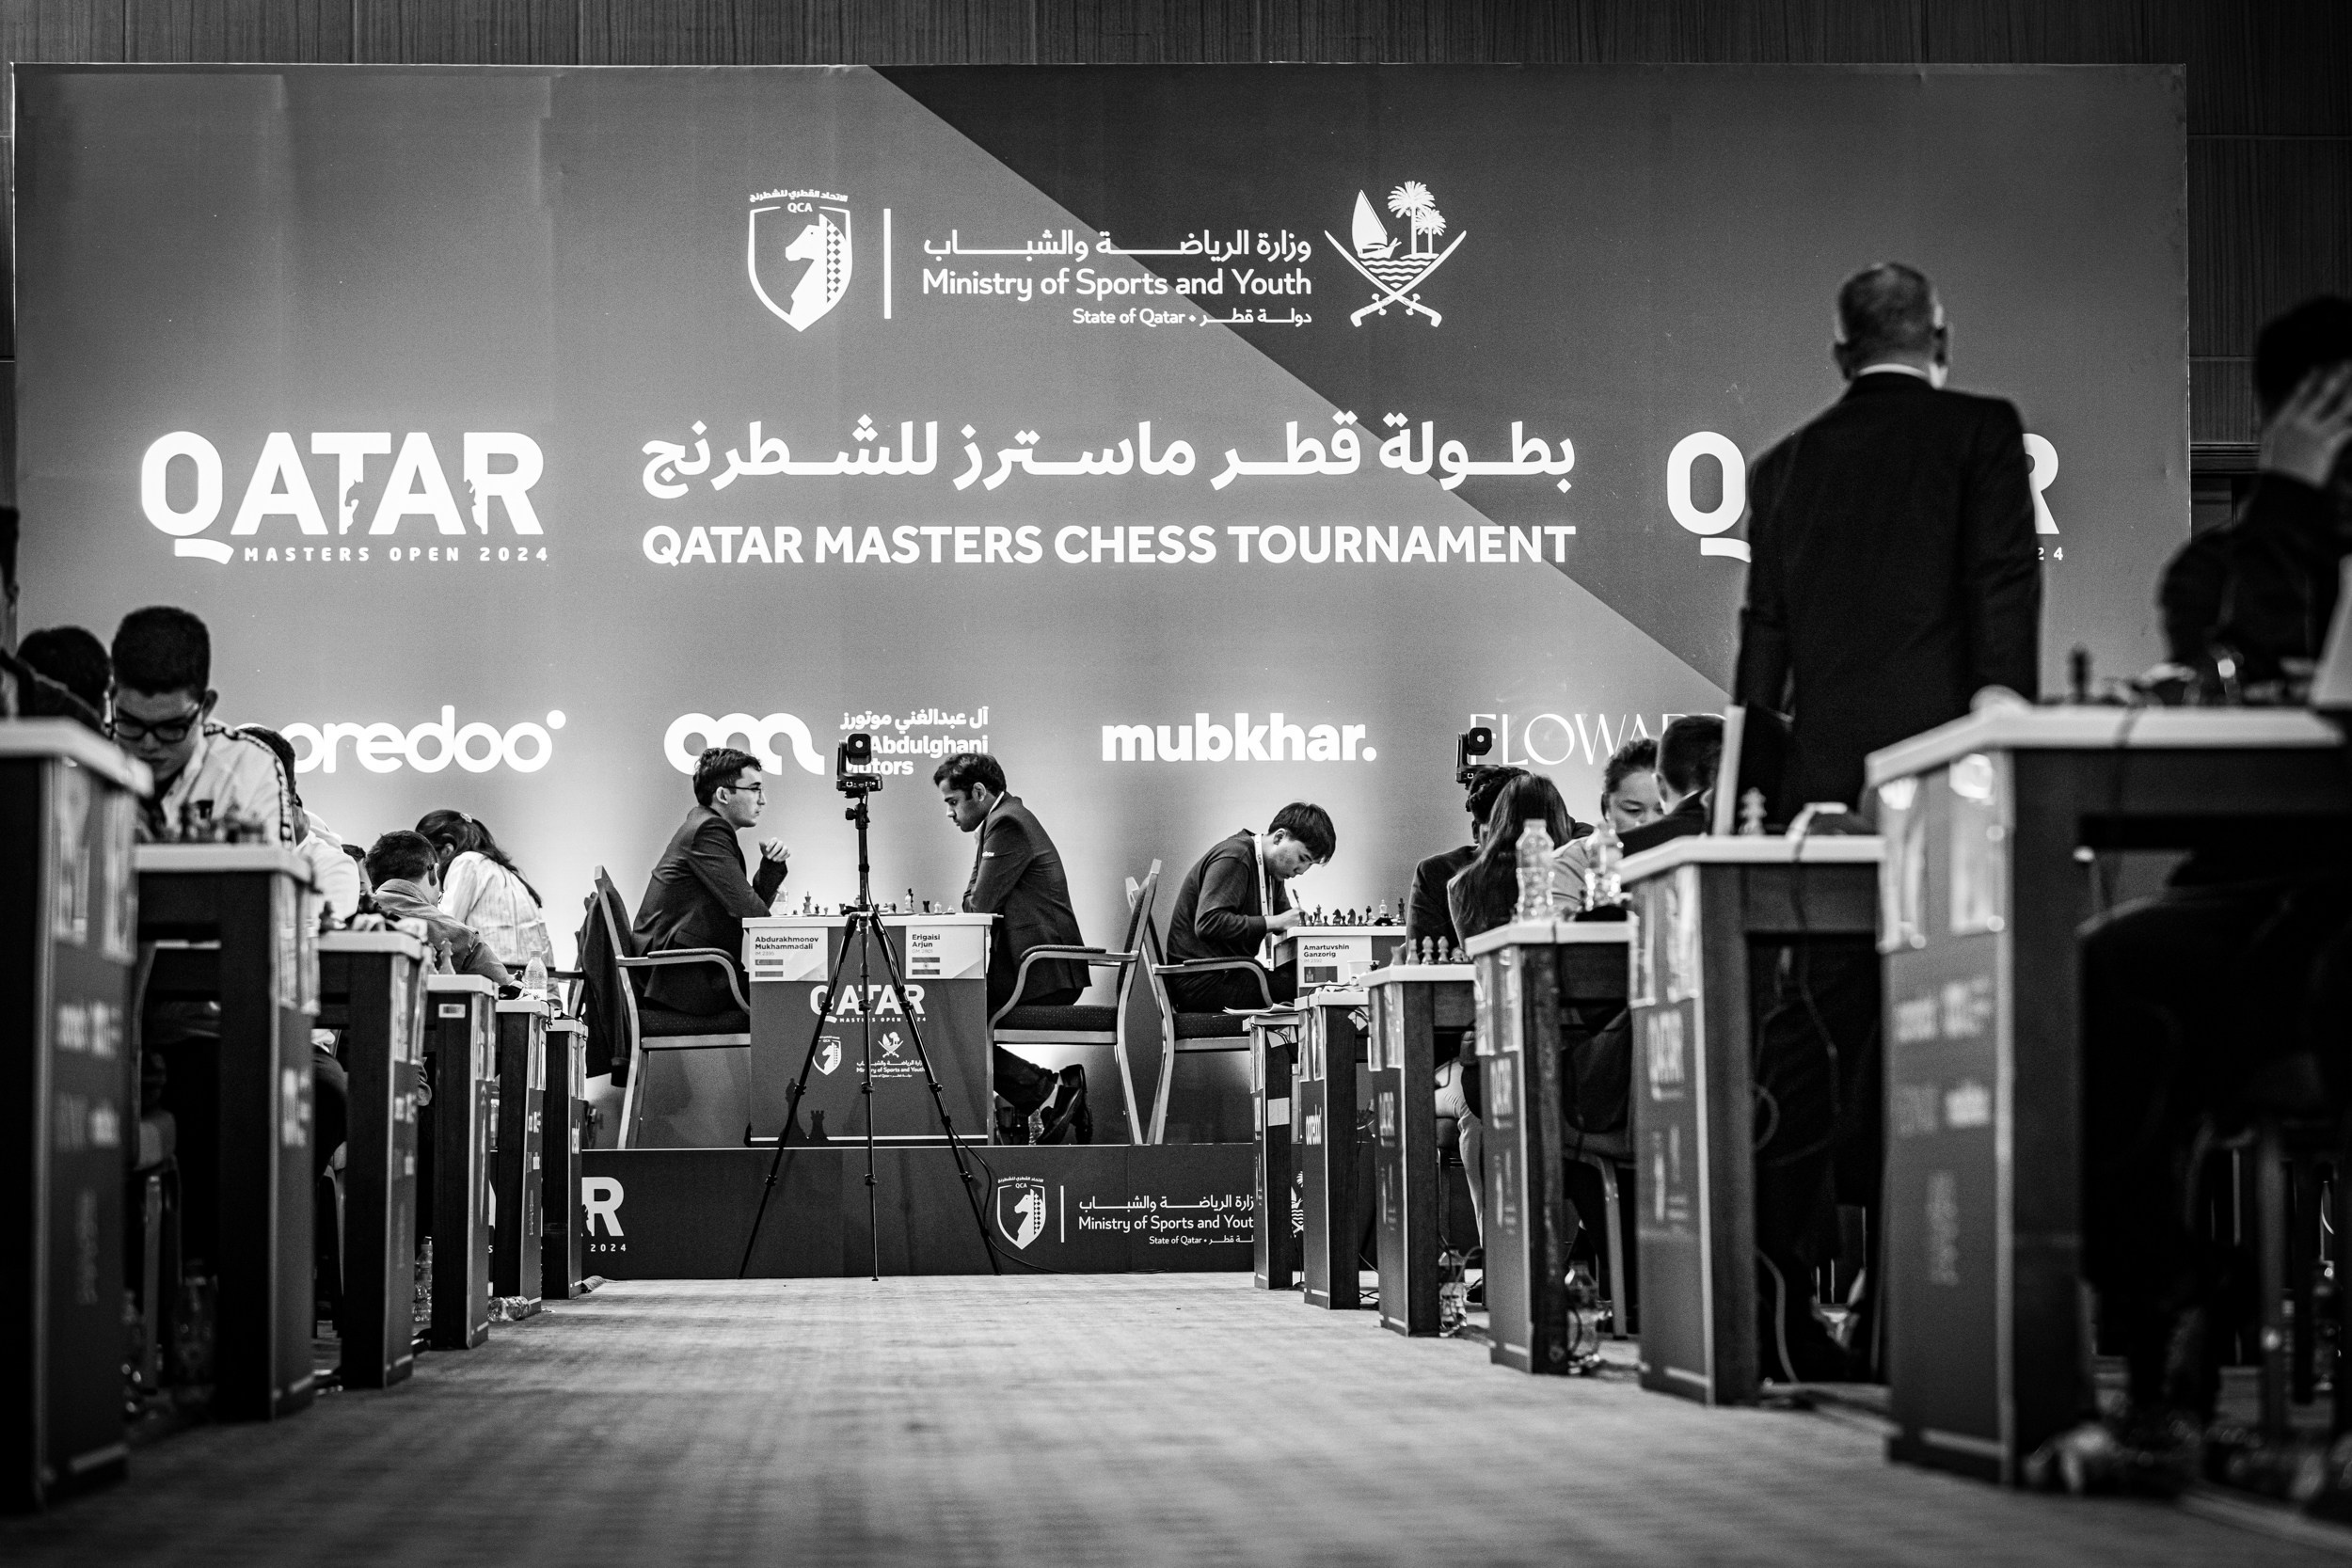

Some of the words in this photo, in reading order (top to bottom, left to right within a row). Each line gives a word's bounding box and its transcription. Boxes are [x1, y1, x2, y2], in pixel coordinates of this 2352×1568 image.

[749, 188, 788, 203] للشطرنج
[788, 188, 820, 200] القطري
[787, 202, 813, 213] QCA
[1256, 230, 1312, 262] وزارة
[922, 268, 1032, 302] Ministry
[1040, 268, 1071, 295] of
[1075, 268, 1168, 302] Sports
[1175, 268, 1223, 295] and
[1231, 268, 1312, 295] Youth
[1072, 308, 1116, 325] State
[1119, 308, 1136, 325] of
[1138, 308, 1185, 326] Qatar
[140, 430, 545, 565] QATAR
[244, 546, 371, 562] MASTERS
[389, 546, 460, 562] OPEN
[479, 546, 549, 562] 2024
[642, 524, 804, 566] QATAR
[815, 524, 1043, 564] MASTERS
[1054, 524, 1217, 564] CHESS
[1226, 524, 1577, 563] TOURNAMENT
[235, 705, 553, 774] oredoo
[1102, 712, 1377, 762] mubkhar.
[870, 735, 989, 759] Abdulghani
[1078, 1216, 1131, 1233] Ministry
[1134, 1215, 1148, 1229] of
[1151, 1214, 1195, 1232] Sports
[1197, 1214, 1220, 1228] and
[1223, 1214, 1254, 1228] Yout
[590, 1243, 627, 1252] 2024
[1149, 1236, 1169, 1244] State
[1170, 1236, 1180, 1244] of
[1180, 1236, 1202, 1245] Qatar
